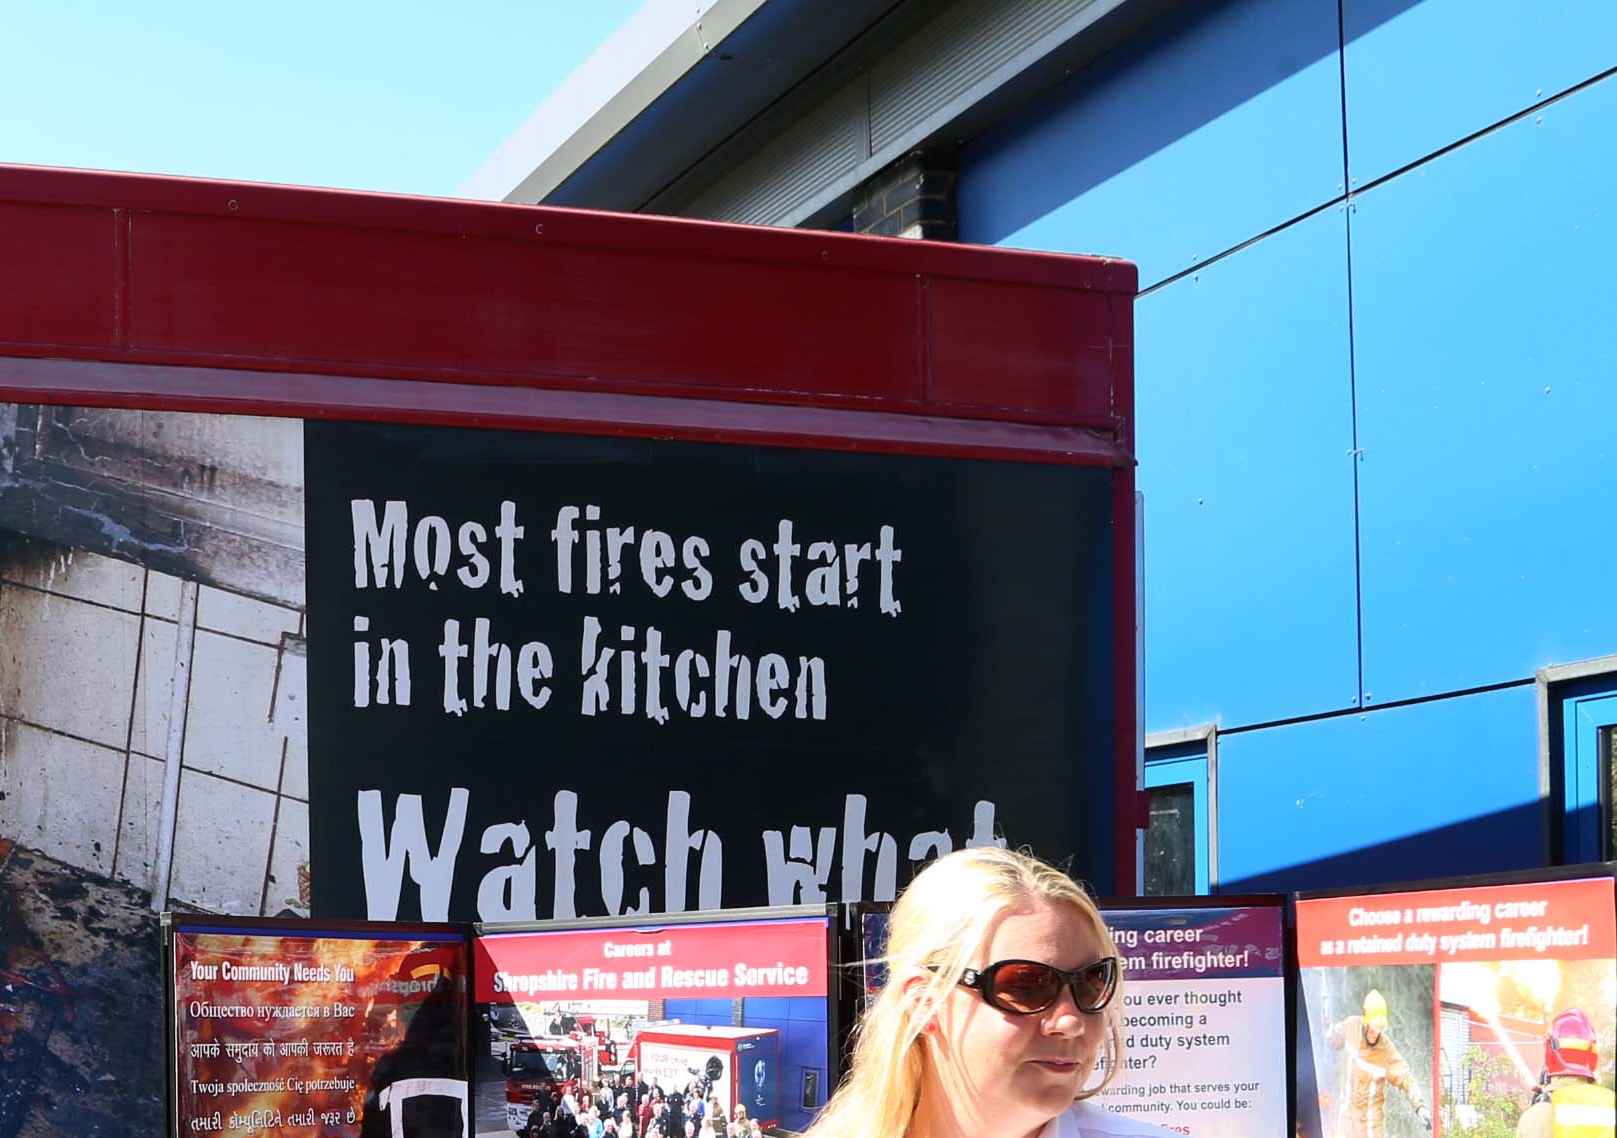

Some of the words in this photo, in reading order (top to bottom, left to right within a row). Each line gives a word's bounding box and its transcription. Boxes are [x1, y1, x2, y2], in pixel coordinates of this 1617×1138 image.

[351, 499, 525, 597] Most
[551, 505, 714, 601] fires
[739, 518, 903, 617] start
[353, 616, 411, 707] in
[439, 617, 553, 716] the
[582, 616, 827, 724] kitchen
[356, 787, 723, 921] Watch
[1349, 907, 1400, 927] Choose
[1416, 901, 1490, 925] rewarding
[1495, 900, 1548, 919] career
[1144, 929, 1203, 943] career
[1347, 933, 1402, 954] retained
[1405, 932, 1437, 955] duty
[1440, 930, 1496, 954] system
[1500, 924, 1589, 951] firefighter!
[604, 942, 649, 958] Careers
[652, 940, 671, 956] at
[1152, 951, 1248, 973] firefighter!
[190, 961, 218, 980] Your
[222, 961, 290, 985] Community
[294, 963, 330, 982] Needs
[334, 964, 354, 982] You
[494, 969, 578, 995] Shropshire
[583, 968, 617, 990] Fire
[622, 966, 655, 989] and
[661, 964, 728, 989] Rescue
[734, 962, 808, 987] Service
[1124, 995, 1142, 1005] ou
[1148, 994, 1179, 1005] ever
[1184, 990, 1242, 1008] thought
[190, 1001, 254, 1018] Общество
[258, 1005, 319, 1021] нуждается
[334, 1002, 354, 1017] Вас
[191, 1039, 220, 1059] आपके
[1141, 1035, 1172, 1050] duty
[1177, 1034, 1230, 1049] system
[191, 1079, 223, 1097] Twoja
[227, 1077, 285, 1097] społeczność
[287, 1077, 304, 1093] Cię
[305, 1077, 354, 1094] potrzebuje
[1148, 1084, 1166, 1098] job
[1170, 1083, 1191, 1094] that
[1194, 1084, 1230, 1094] serves
[1234, 1082, 1259, 1094] your
[1108, 1101, 1173, 1114] community.
[1177, 1100, 1197, 1111] You
[1201, 1099, 1230, 1110] could
